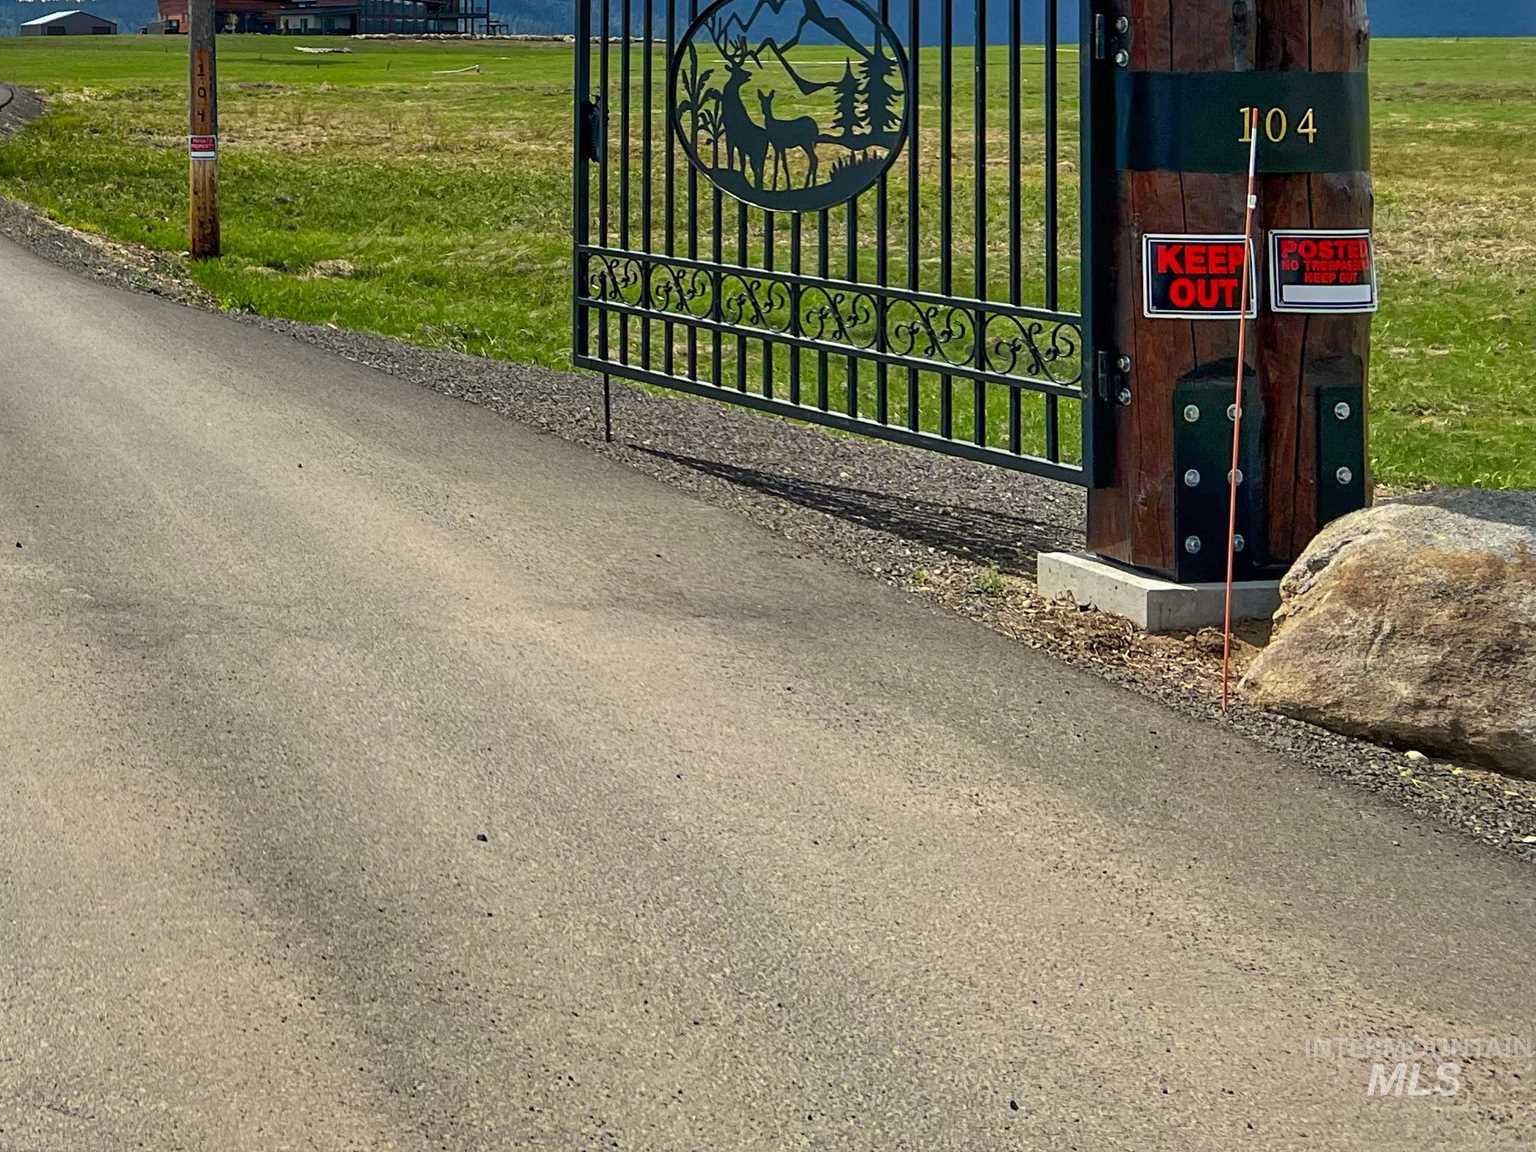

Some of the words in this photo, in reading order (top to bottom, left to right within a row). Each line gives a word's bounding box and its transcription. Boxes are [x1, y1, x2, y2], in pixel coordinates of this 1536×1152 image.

[1238, 107, 1317, 144] 104
[1157, 244, 1246, 274] KEEP
[1281, 259, 1300, 271] NO
[1169, 278, 1238, 308] OUT
